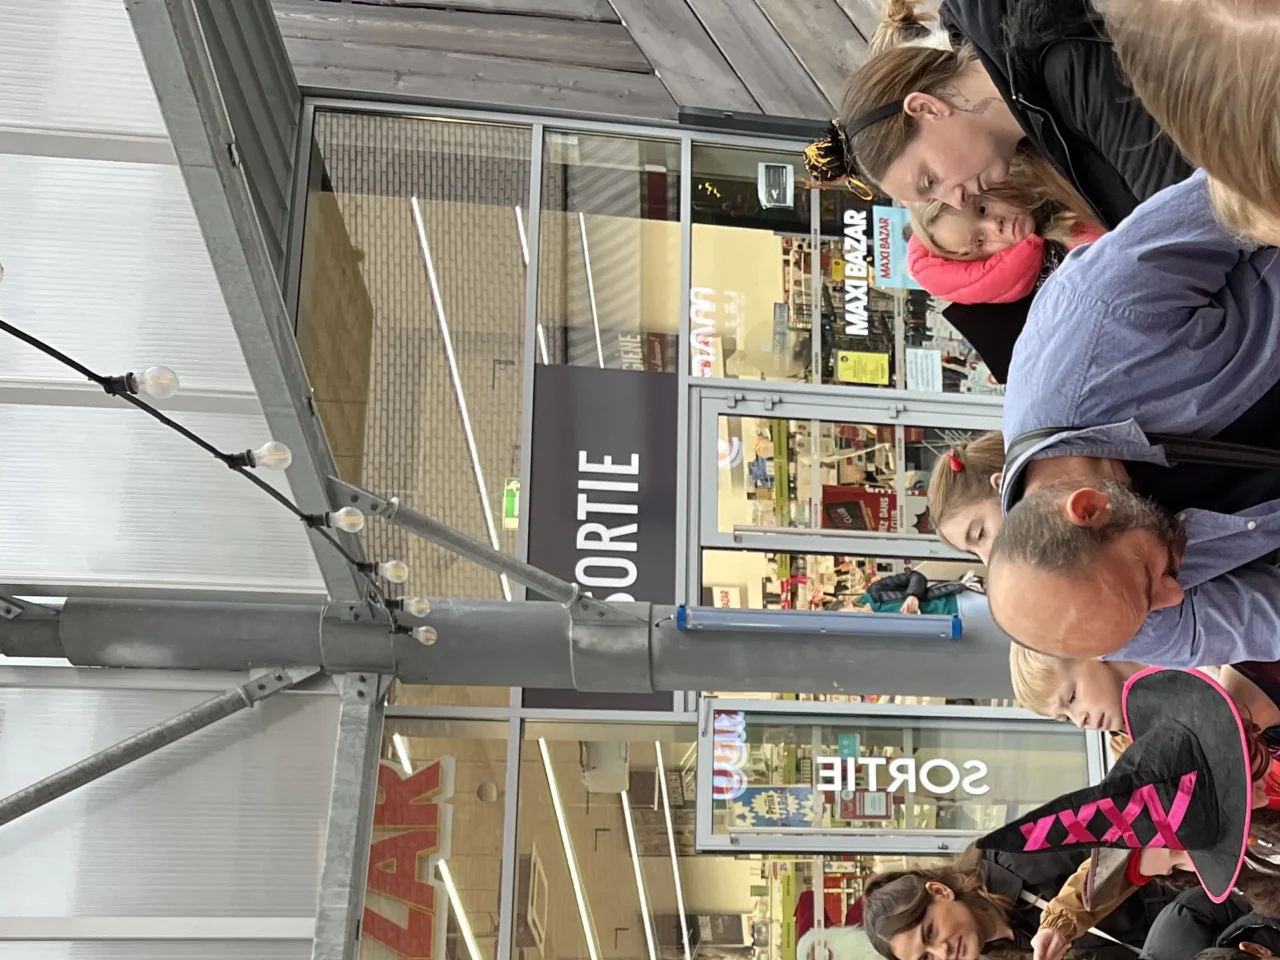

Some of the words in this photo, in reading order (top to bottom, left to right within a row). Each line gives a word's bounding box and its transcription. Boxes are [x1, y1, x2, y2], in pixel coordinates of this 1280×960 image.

[843, 209, 867, 277] BAZAR
[879, 217, 890, 249] BAZAR
[880, 251, 891, 279] MAXI
[845, 280, 869, 335] MAXI
